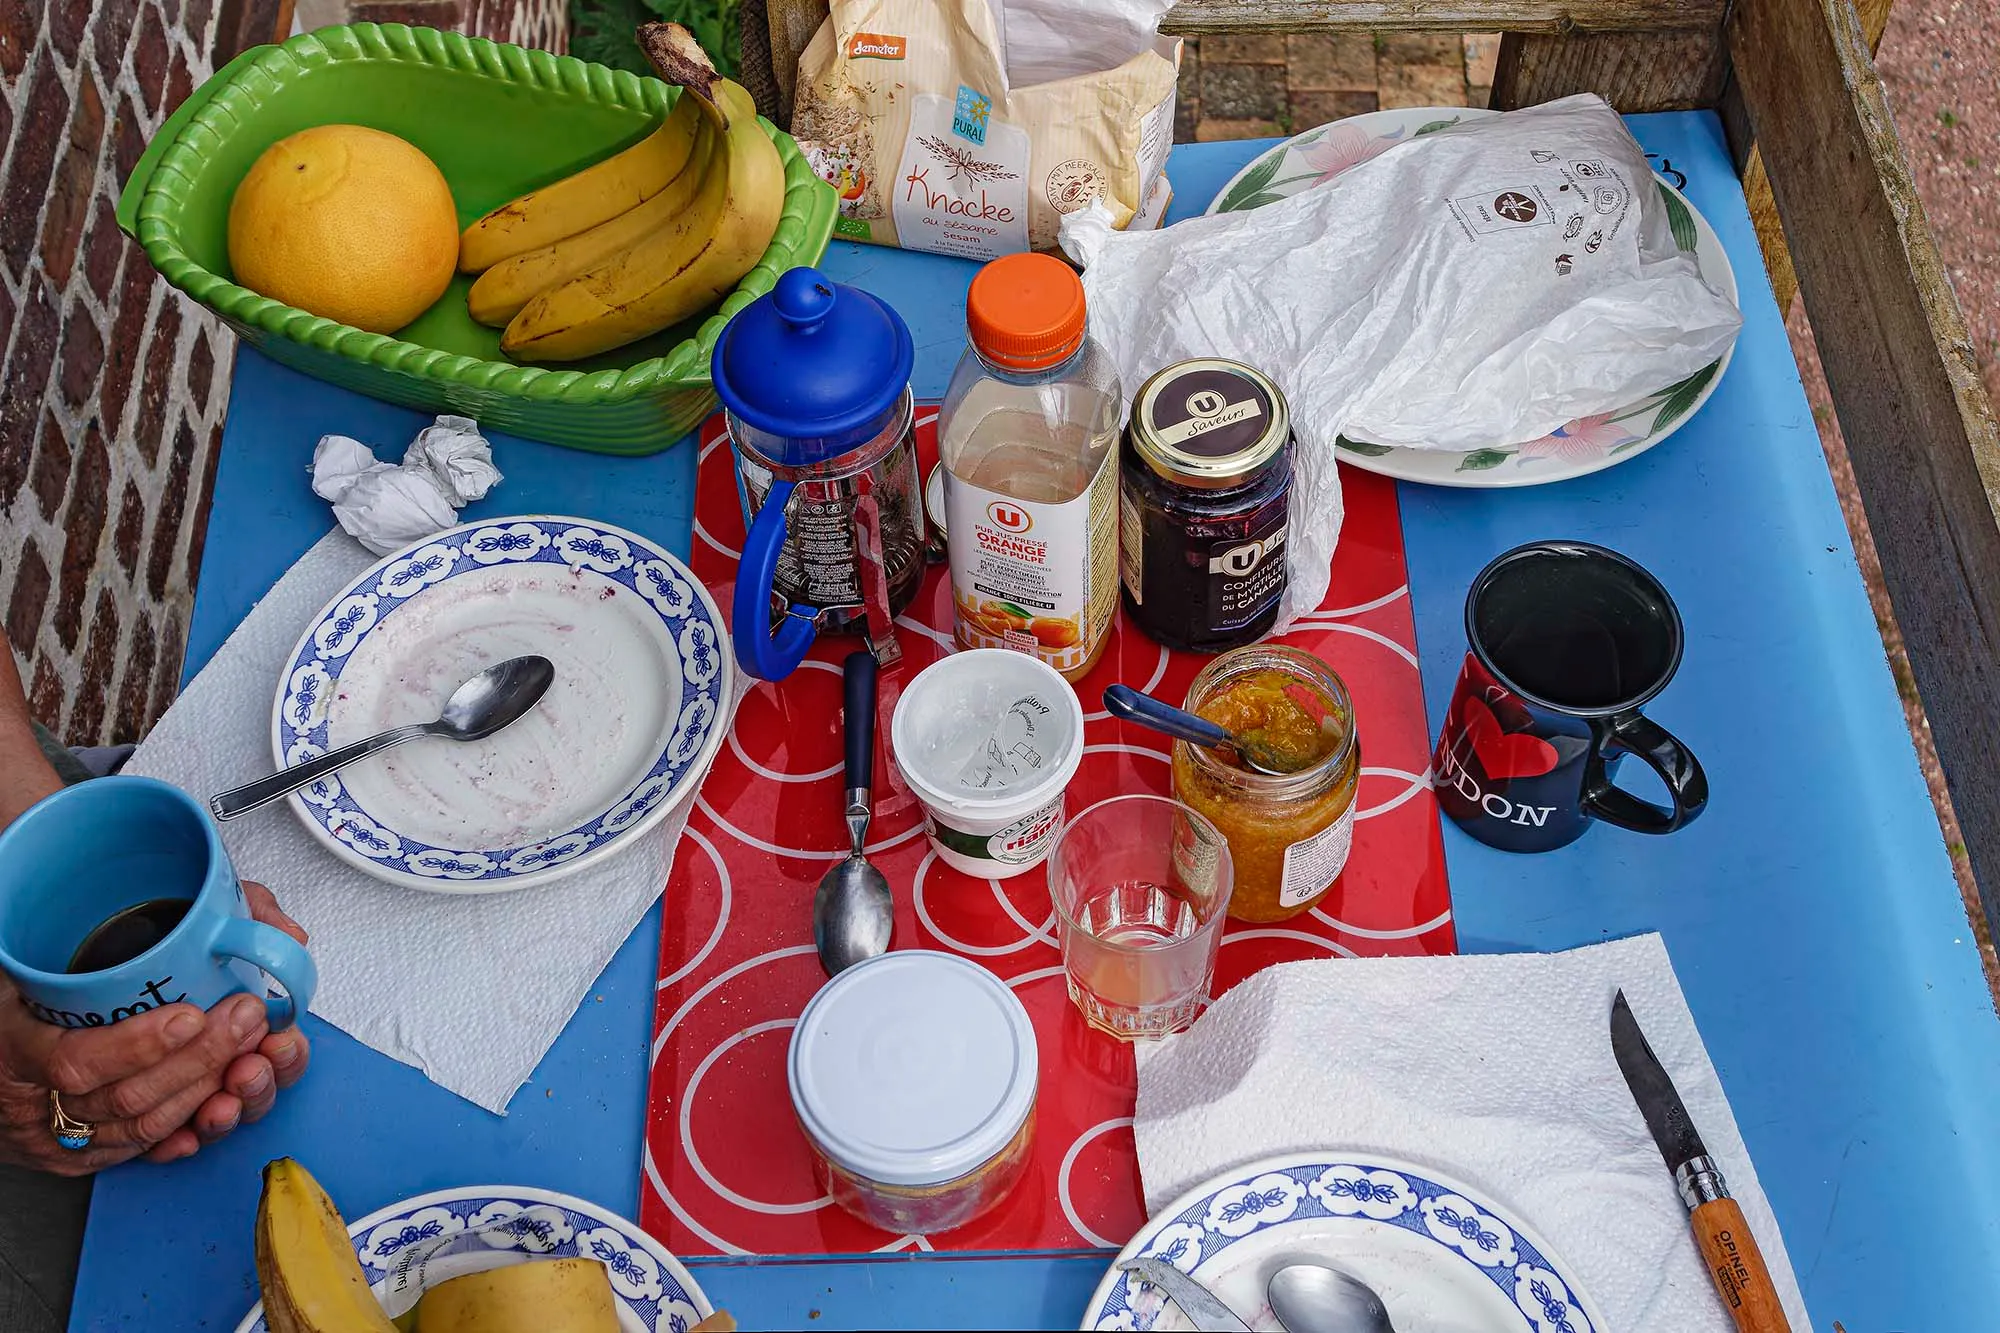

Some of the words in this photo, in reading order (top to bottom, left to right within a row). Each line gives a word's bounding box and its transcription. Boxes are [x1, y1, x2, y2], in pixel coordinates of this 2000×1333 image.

[854, 40, 899, 55] demeter
[953, 117, 984, 142] PURAL
[1051, 168, 1064, 181] MIT
[1065, 161, 1106, 181] MEERSALZ
[906, 164, 1015, 223] Knäcke
[1049, 186, 1063, 209] AVEC
[922, 217, 938, 226] au
[943, 231, 981, 243] Sesam
[1193, 395, 1217, 413] U
[1188, 408, 1246, 436] Saveurs
[997, 508, 1020, 527] U
[975, 524, 993, 535] PUR
[995, 531, 1012, 541] JUS
[1014, 536, 1048, 548] PRESSÉ
[977, 532, 1046, 557] ORANGE
[980, 541, 1007, 556] SANS
[1010, 551, 1045, 564] PULPE
[1232, 548, 1255, 571] U
[1238, 574, 1282, 608] CANADA
[1006, 631, 1036, 642] ORANGE
[1011, 644, 1031, 653] SANS
[1440, 733, 1557, 827] NDON
[1007, 811, 1059, 851] rians
[1720, 1230, 1751, 1290] OPINEL
